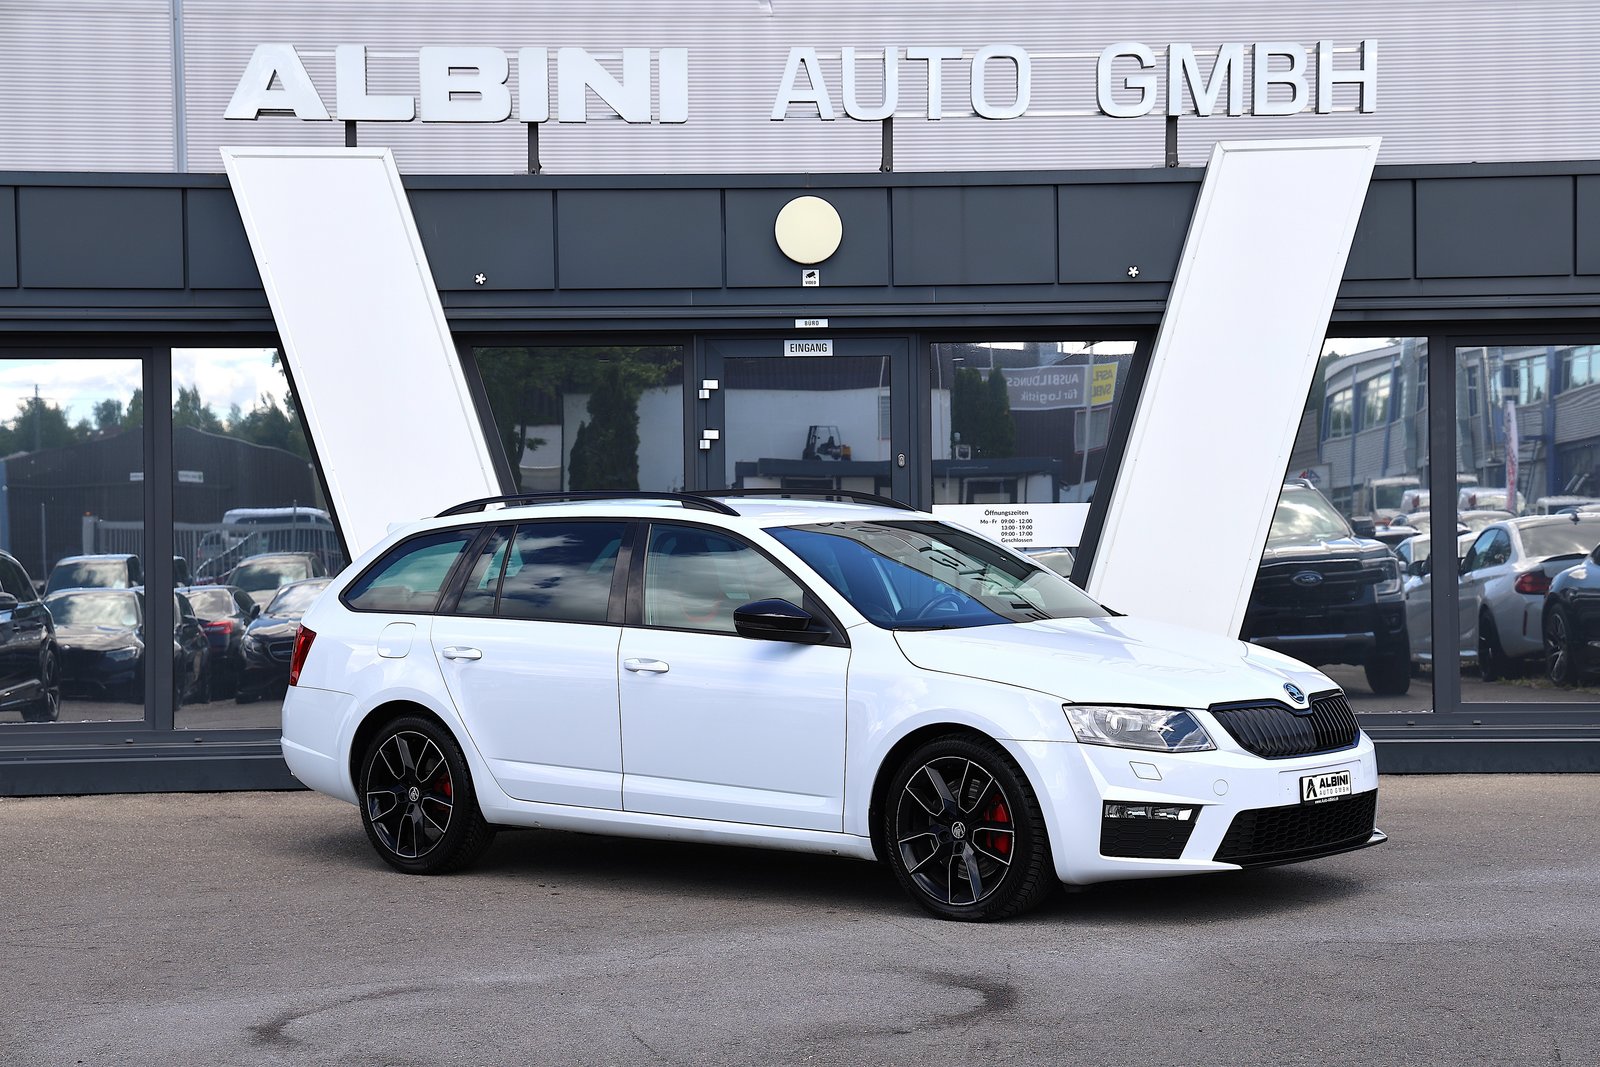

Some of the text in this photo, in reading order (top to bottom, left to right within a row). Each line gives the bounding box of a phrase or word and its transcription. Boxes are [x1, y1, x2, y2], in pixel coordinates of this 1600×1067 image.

[223, 39, 1379, 124] ALBINI AUTO GMBH
[789, 343, 828, 353] EINGANG
[1320, 774, 1348, 788] ALBINI
